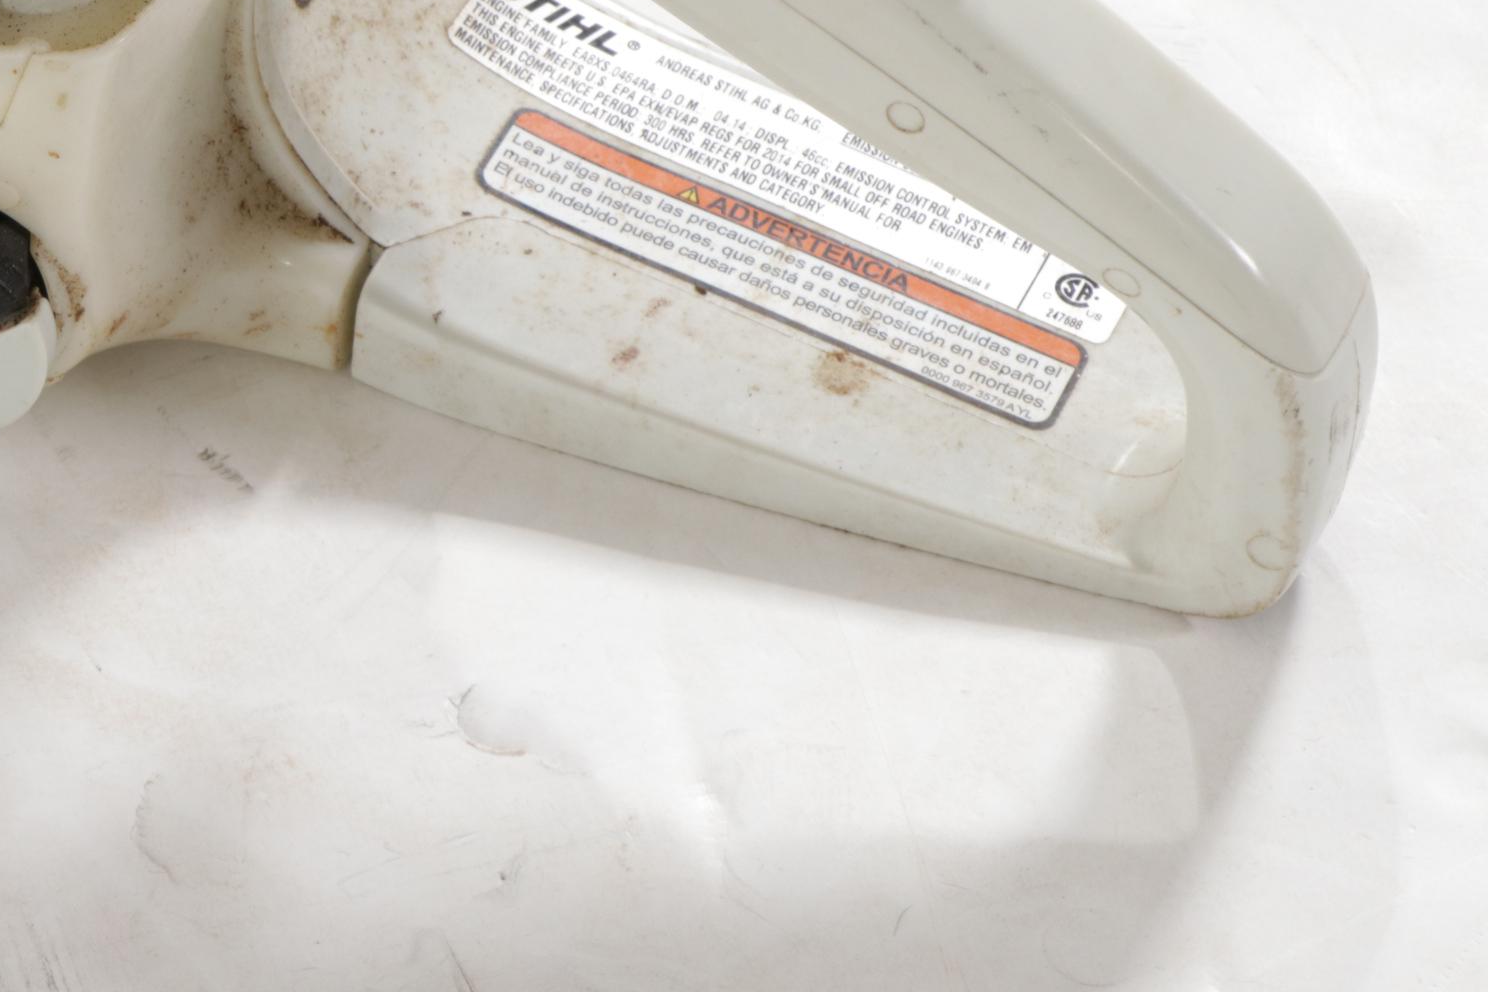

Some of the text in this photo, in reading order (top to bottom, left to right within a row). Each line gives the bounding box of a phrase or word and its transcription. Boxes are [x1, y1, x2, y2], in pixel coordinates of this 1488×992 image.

[463, 14, 516, 54] EMISSION
[518, 50, 591, 95] COMPLIANCE
[643, 114, 666, 131] 300
[700, 138, 741, 161] REFER
[744, 154, 761, 170] TO
[762, 163, 819, 194] OWNER'S
[821, 188, 869, 218] MANUAL
[875, 212, 901, 231] FOR
[472, 1, 498, 25] THIS
[499, 21, 540, 52] ENGINE
[542, 48, 583, 75] MEETS
[611, 83, 635, 100] EPA
[699, 121, 733, 142] REGS
[735, 136, 760, 153] FOR
[761, 147, 791, 166] 2014
[793, 160, 819, 178] FOR
[821, 172, 859, 197] SMALL
[864, 191, 889, 207] OFF
[891, 202, 926, 224] ROAD
[640, 128, 728, 173] ADJUSTMENTS
[730, 167, 756, 184] AND
[656, 56, 712, 85] ANDREAS
[714, 79, 747, 101] STIHL
[751, 95, 770, 109] AG
[772, 104, 781, 115] &
[493, 160, 1044, 409] El uso indebido puede causar daños personales graves o mortales.
[503, 149, 1051, 393] manual de instrucciones, que está a su disposición en español.
[511, 132, 1061, 378] Lea y siga todas las precauciones de seguridad incluidas en el
[706, 197, 906, 289] ADVERTENCIA
[835, 162, 893, 193] EMISSION
[896, 188, 949, 218] CONTROL
[1012, 237, 1034, 253] EM
[920, 365, 1031, 421] 0000 967 3579 A YL
